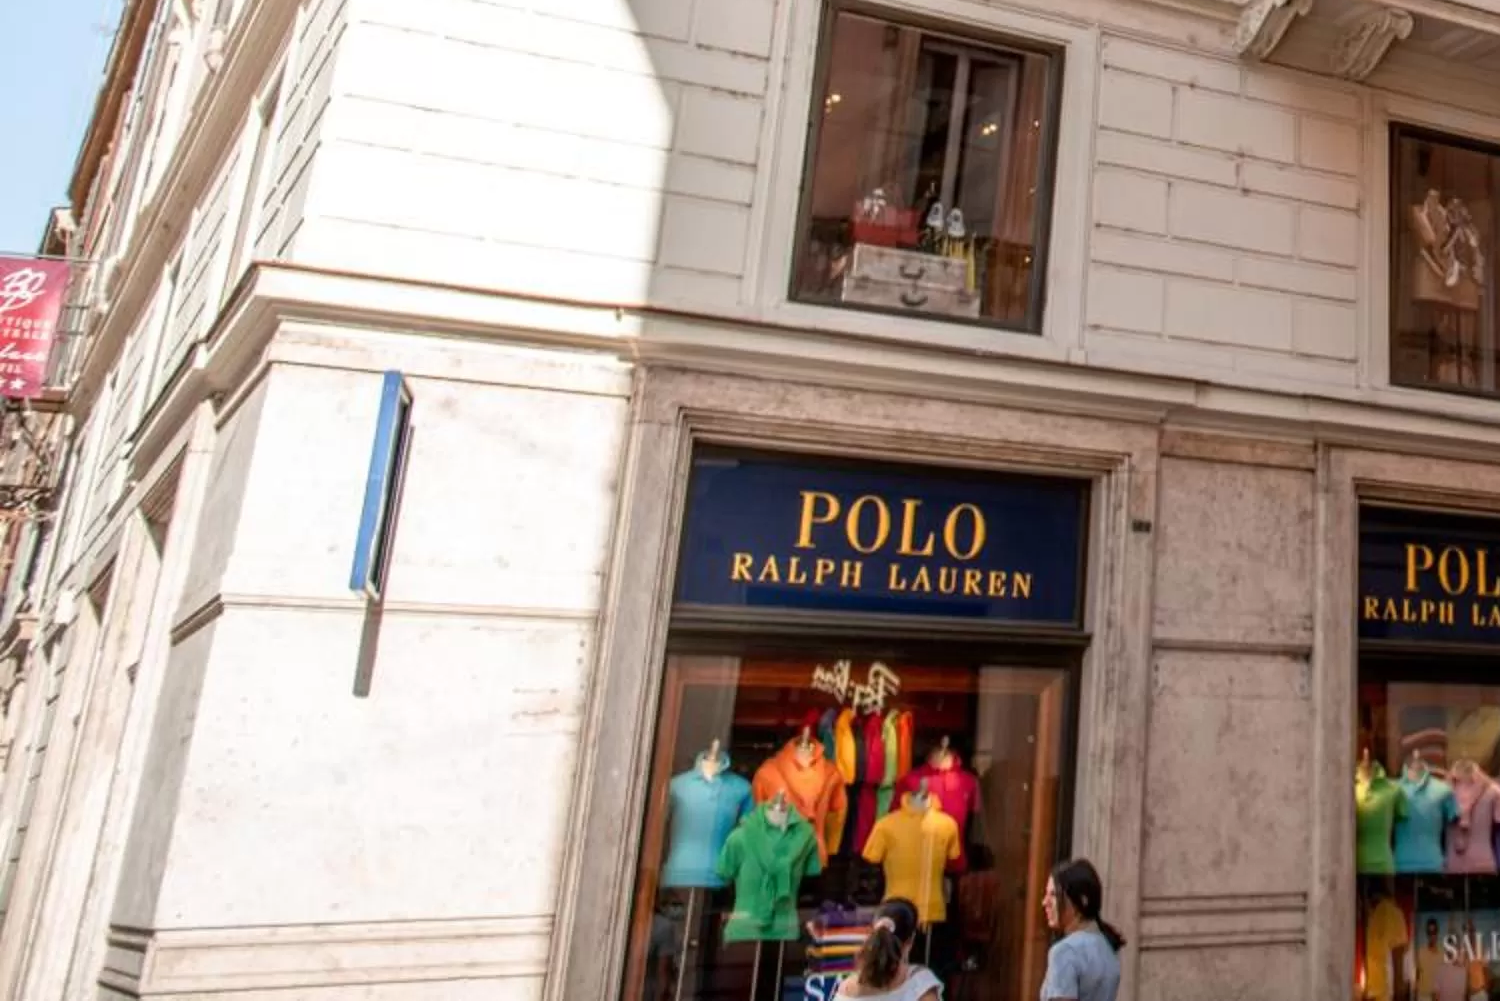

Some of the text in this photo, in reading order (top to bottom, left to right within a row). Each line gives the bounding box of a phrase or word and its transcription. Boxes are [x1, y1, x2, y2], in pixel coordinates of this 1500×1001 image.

[794, 491, 987, 560] POLO
[730, 552, 1033, 599] RALPH LAUREN
[1363, 596, 1454, 625] RALPH
